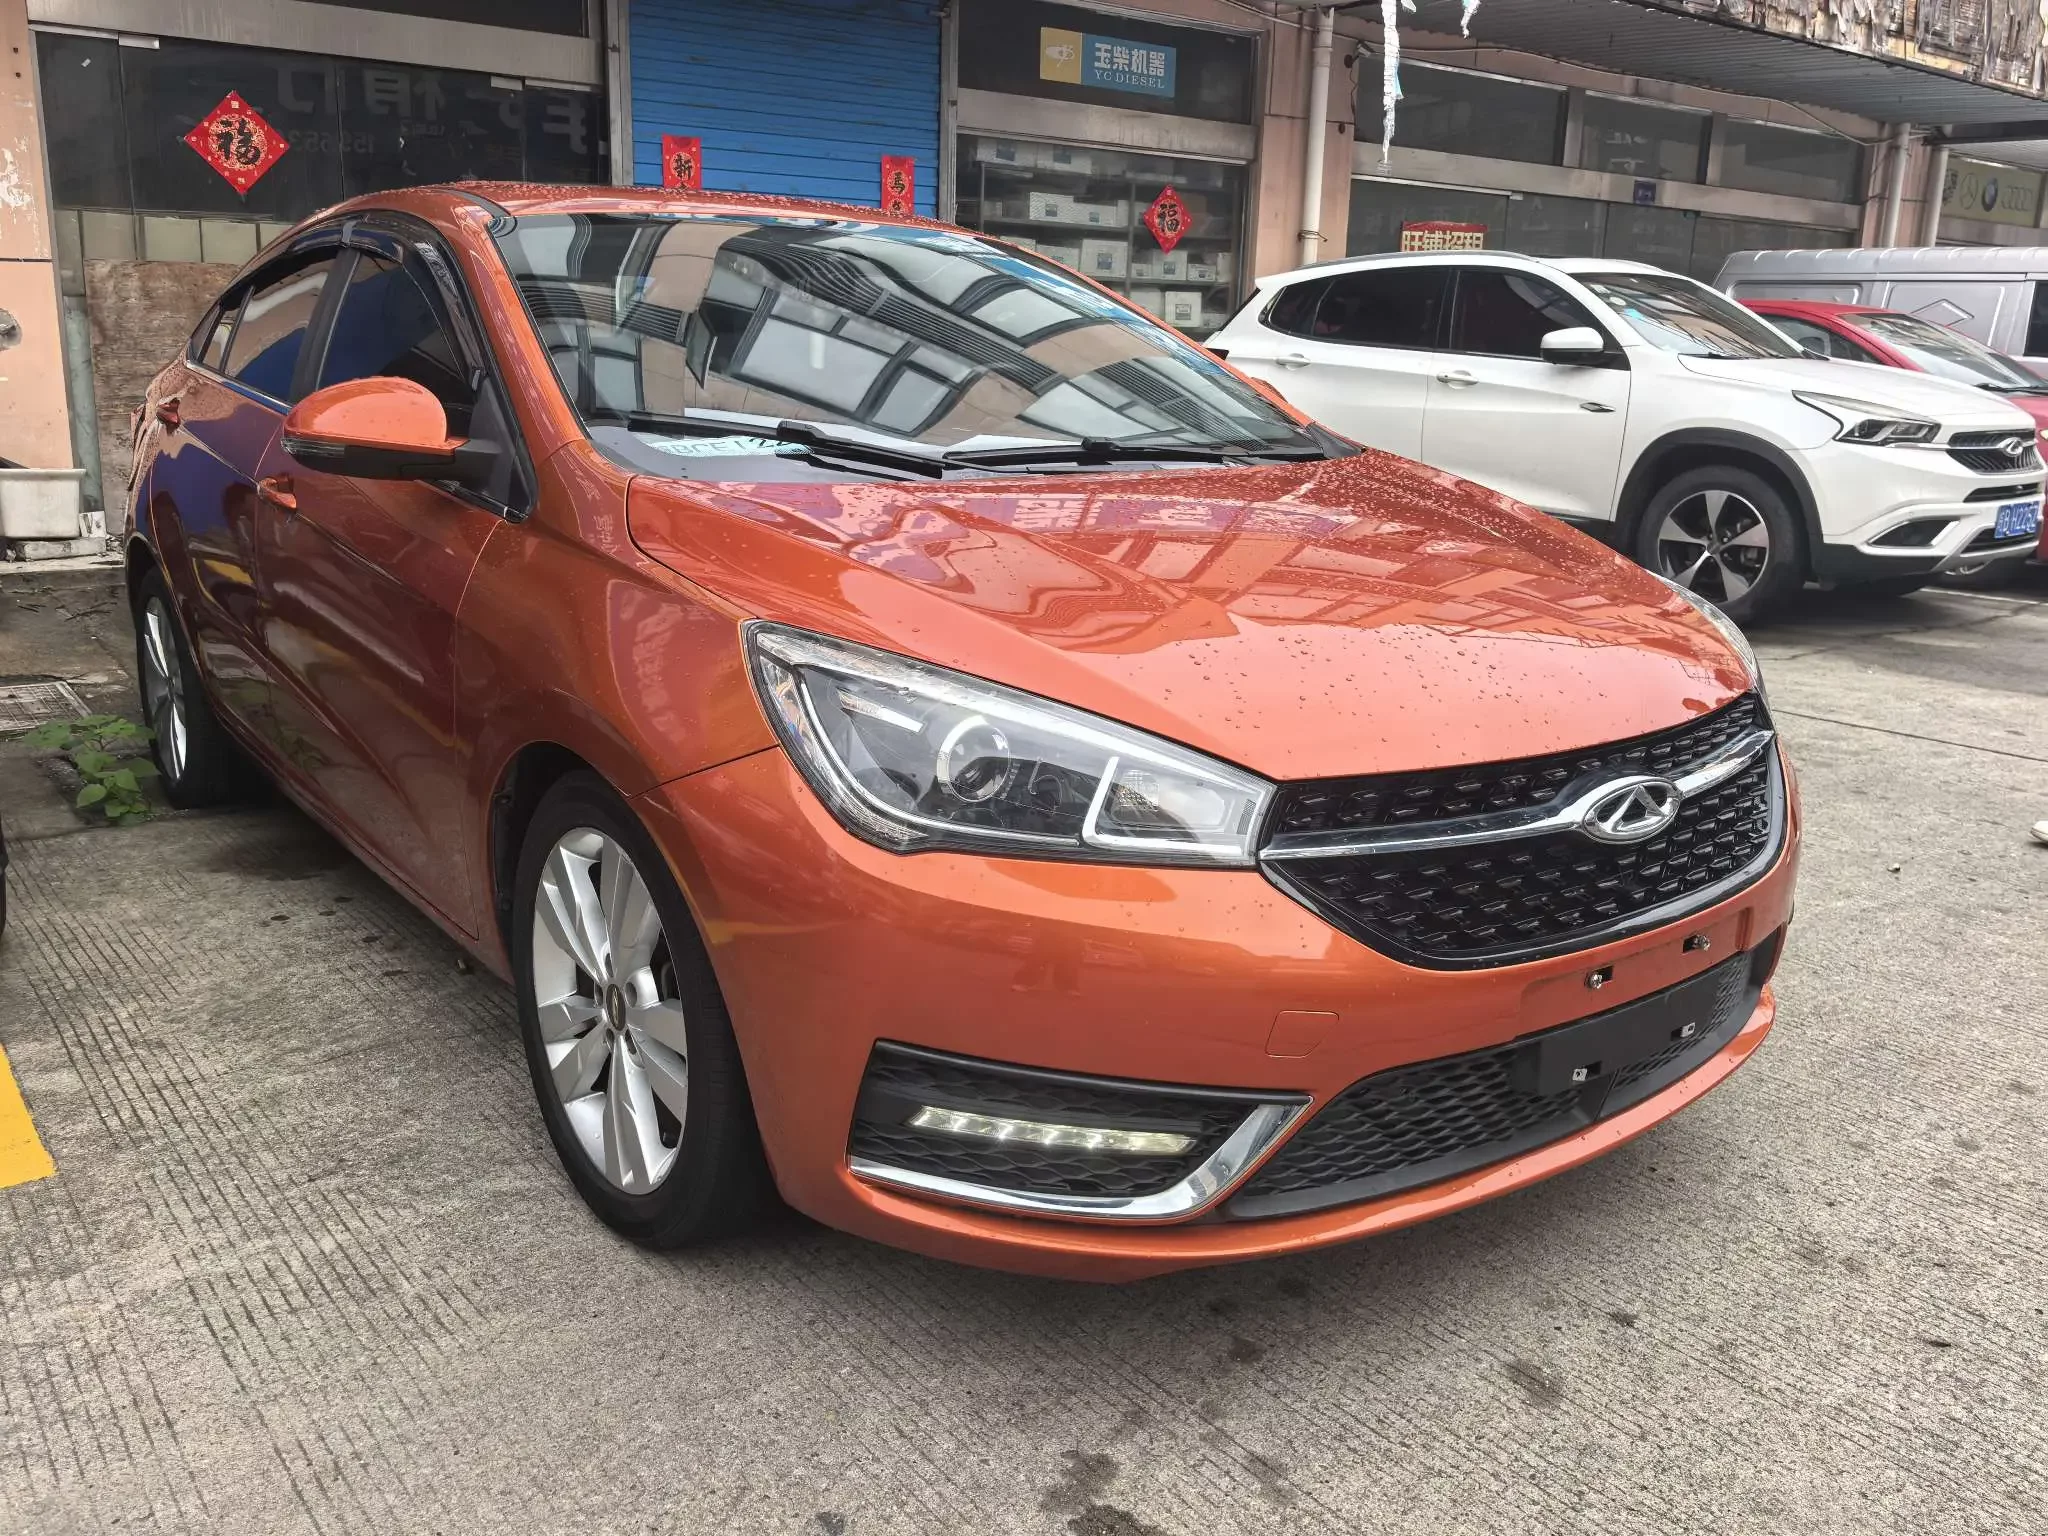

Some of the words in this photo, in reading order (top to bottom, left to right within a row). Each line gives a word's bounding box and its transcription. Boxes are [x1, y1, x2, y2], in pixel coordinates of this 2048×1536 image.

[1094, 42, 1166, 77] 玉柴机器
[1094, 69, 1113, 81] YC
[1115, 72, 1165, 89] DIESEL
[216, 117, 262, 166] 福
[1157, 202, 1180, 233] 福
[1401, 229, 1485, 252] 旺铺招租
